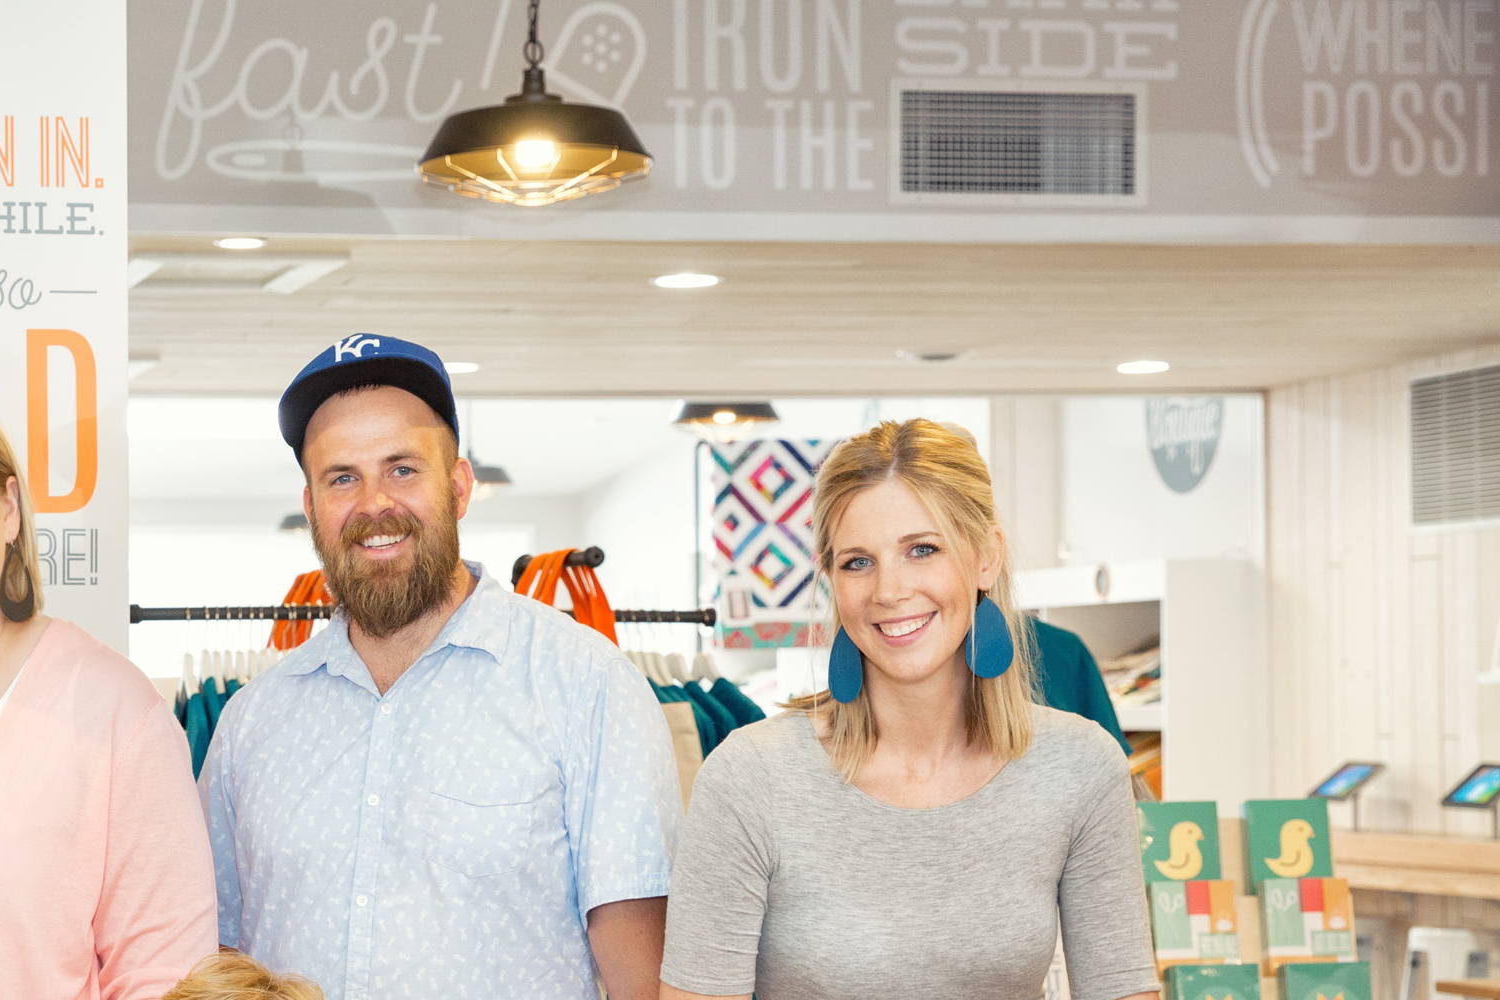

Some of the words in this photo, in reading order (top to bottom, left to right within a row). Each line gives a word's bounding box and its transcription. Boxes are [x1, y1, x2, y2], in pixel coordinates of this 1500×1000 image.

[893, 16, 1180, 80] SIDE
[39, 116, 105, 189] IN.
[667, 96, 738, 190] TO
[764, 98, 876, 191] THE
[1302, 79, 1490, 178] POSSI
[334, 334, 380, 362] KC
[34, 528, 100, 587] RE!
